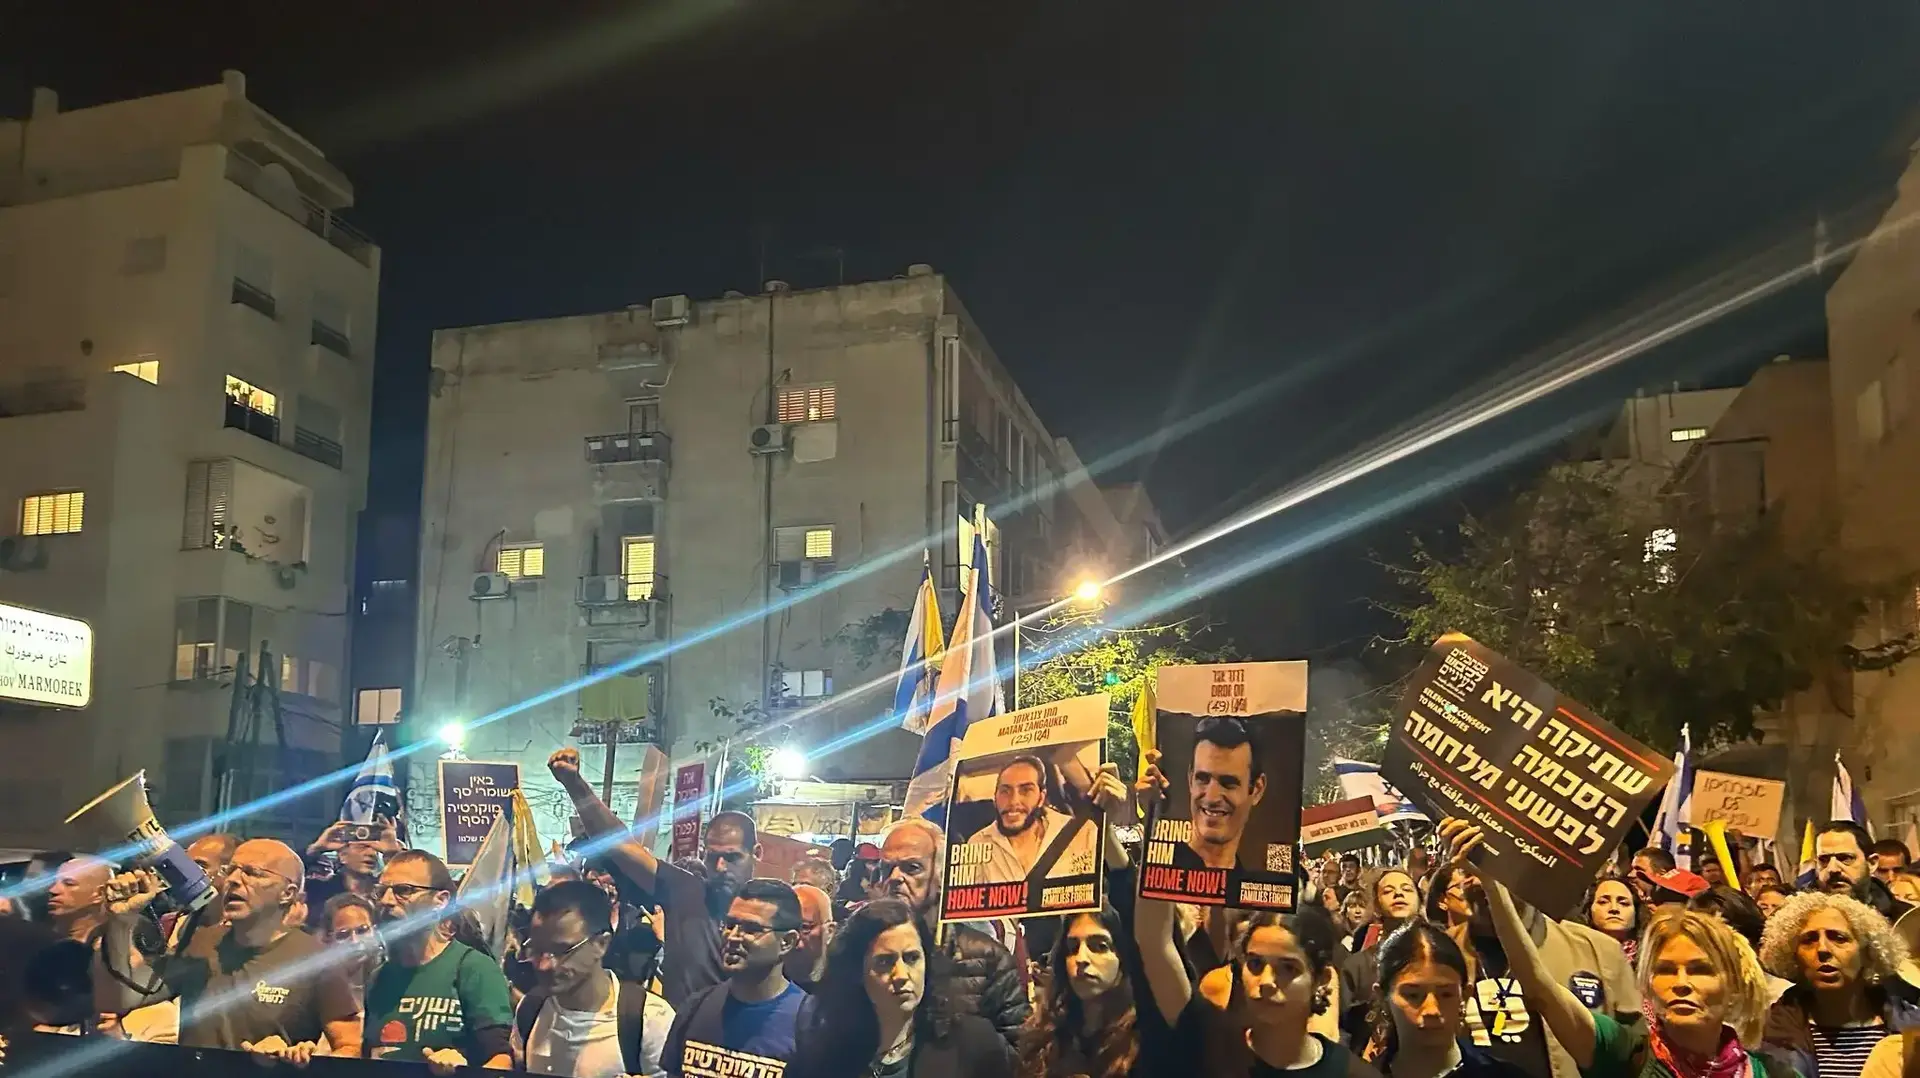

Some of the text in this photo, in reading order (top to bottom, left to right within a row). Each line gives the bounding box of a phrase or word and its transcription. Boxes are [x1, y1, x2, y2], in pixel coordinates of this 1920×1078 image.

[18, 673, 82, 697] MARMOREK
[1207, 699, 1230, 713] (49)
[1419, 694, 1429, 705] TO
[1427, 700, 1444, 716] WAR
[1442, 711, 1470, 732] CRIMES
[1481, 680, 1543, 731] היא
[998, 715, 1069, 737] MATAN ZANGAUKER
[1456, 709, 1492, 734] CONSENT
[1538, 717, 1653, 795] שתיקה
[453, 787, 511, 799] שומרי סף
[469, 776, 494, 788] באין
[1404, 710, 1606, 855] לפשעי מלחמה
[1512, 744, 1628, 829] הסכמה
[950, 843, 993, 865] BRING
[1147, 841, 1175, 865] HIM
[949, 864, 977, 887] HIM
[1145, 866, 1227, 895] HOME NOW!
[946, 881, 1028, 910] HOME NOW!
[1240, 889, 1291, 905] FAMILIES FORUM
